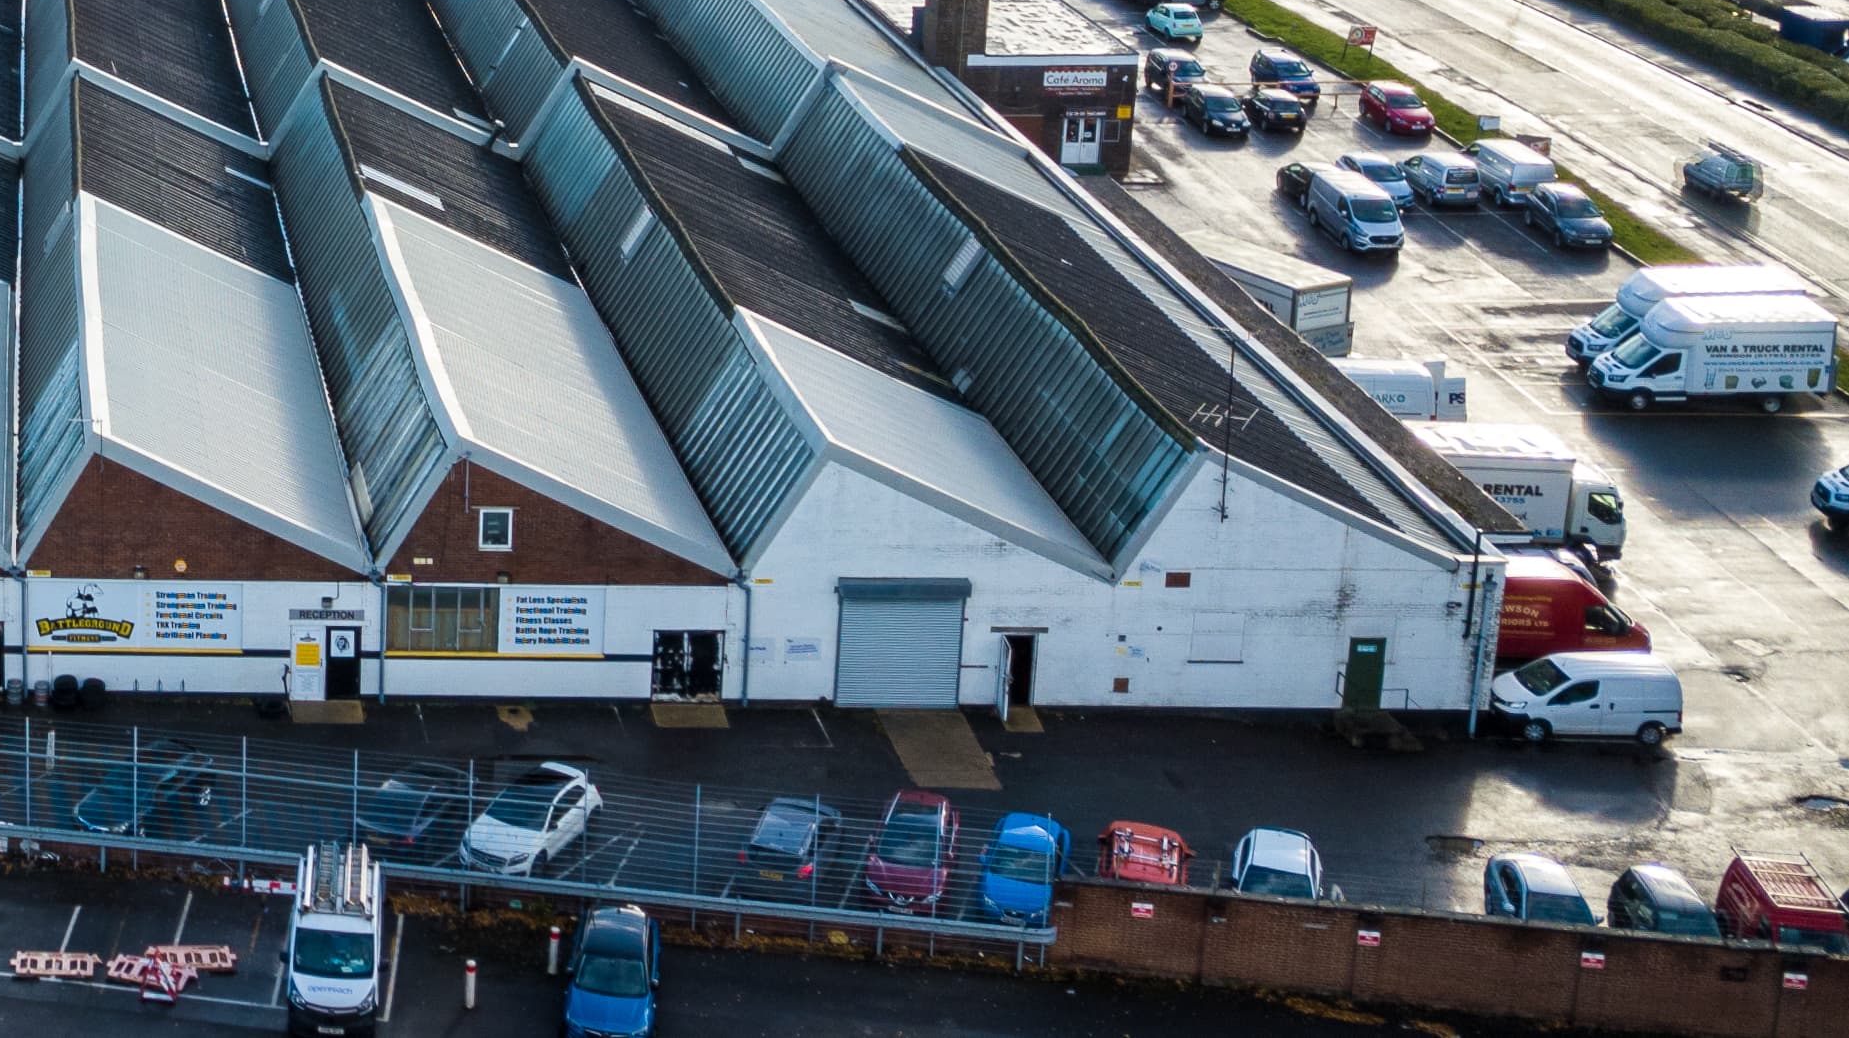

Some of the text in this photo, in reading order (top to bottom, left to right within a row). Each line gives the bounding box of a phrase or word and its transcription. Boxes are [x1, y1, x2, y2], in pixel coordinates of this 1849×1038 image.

[1046, 74, 1104, 85] Café Aroma
[1705, 344, 1826, 353] VAN & TRUCK RENTAL
[1482, 483, 1544, 497] RENTAL
[516, 596, 528, 604] Fat
[529, 596, 545, 604] Loss
[299, 609, 355, 620] RECEPTION
[1502, 603, 1540, 618] WSON
[515, 616, 573, 624] Fitness Classes
[1534, 619, 1550, 628] LTD
[37, 617, 133, 638] BATTLEGROUND
[68, 633, 100, 642] FITNESS
[307, 985, 353, 995] openreach
